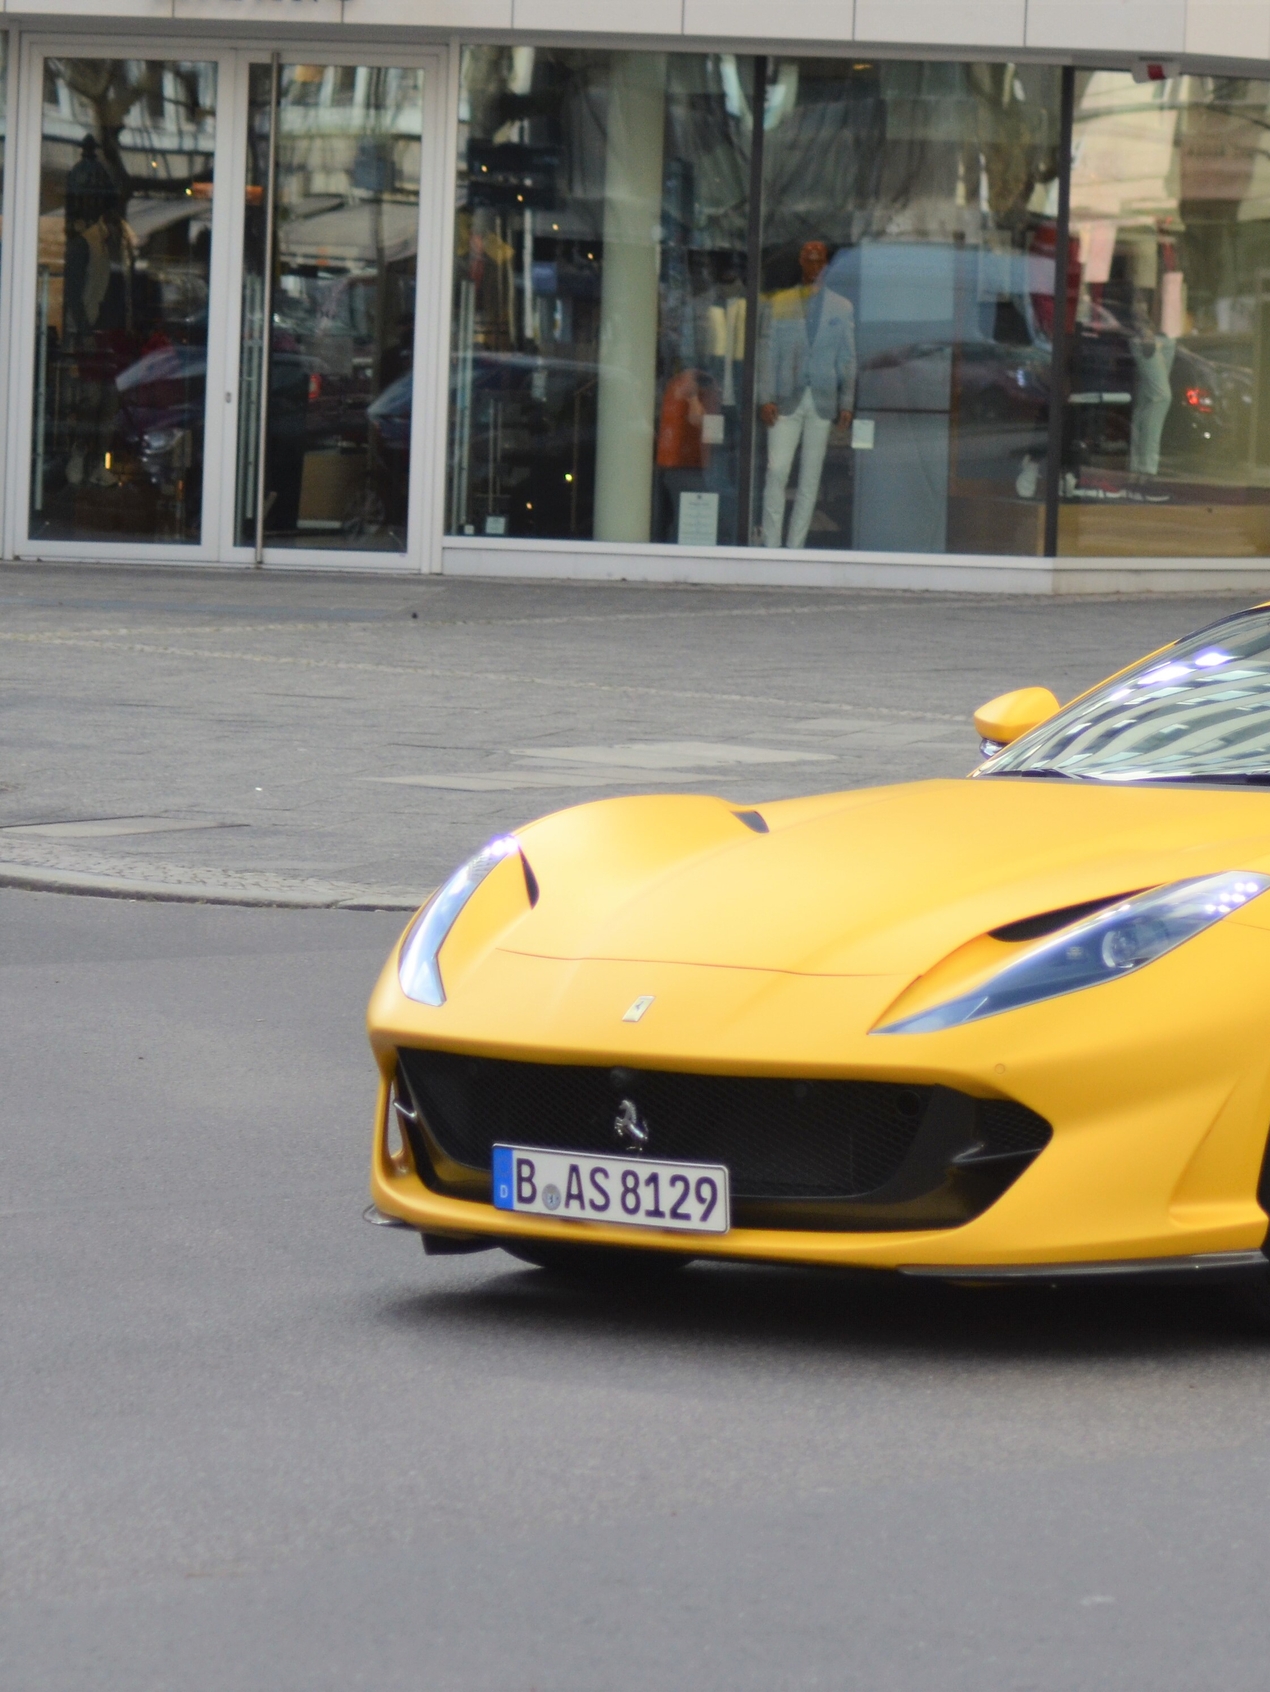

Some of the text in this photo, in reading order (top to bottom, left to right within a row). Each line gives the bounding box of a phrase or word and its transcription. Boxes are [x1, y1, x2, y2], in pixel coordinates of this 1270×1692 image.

[500, 1184, 508, 1198] D
[516, 1157, 718, 1223] B AS 8129
